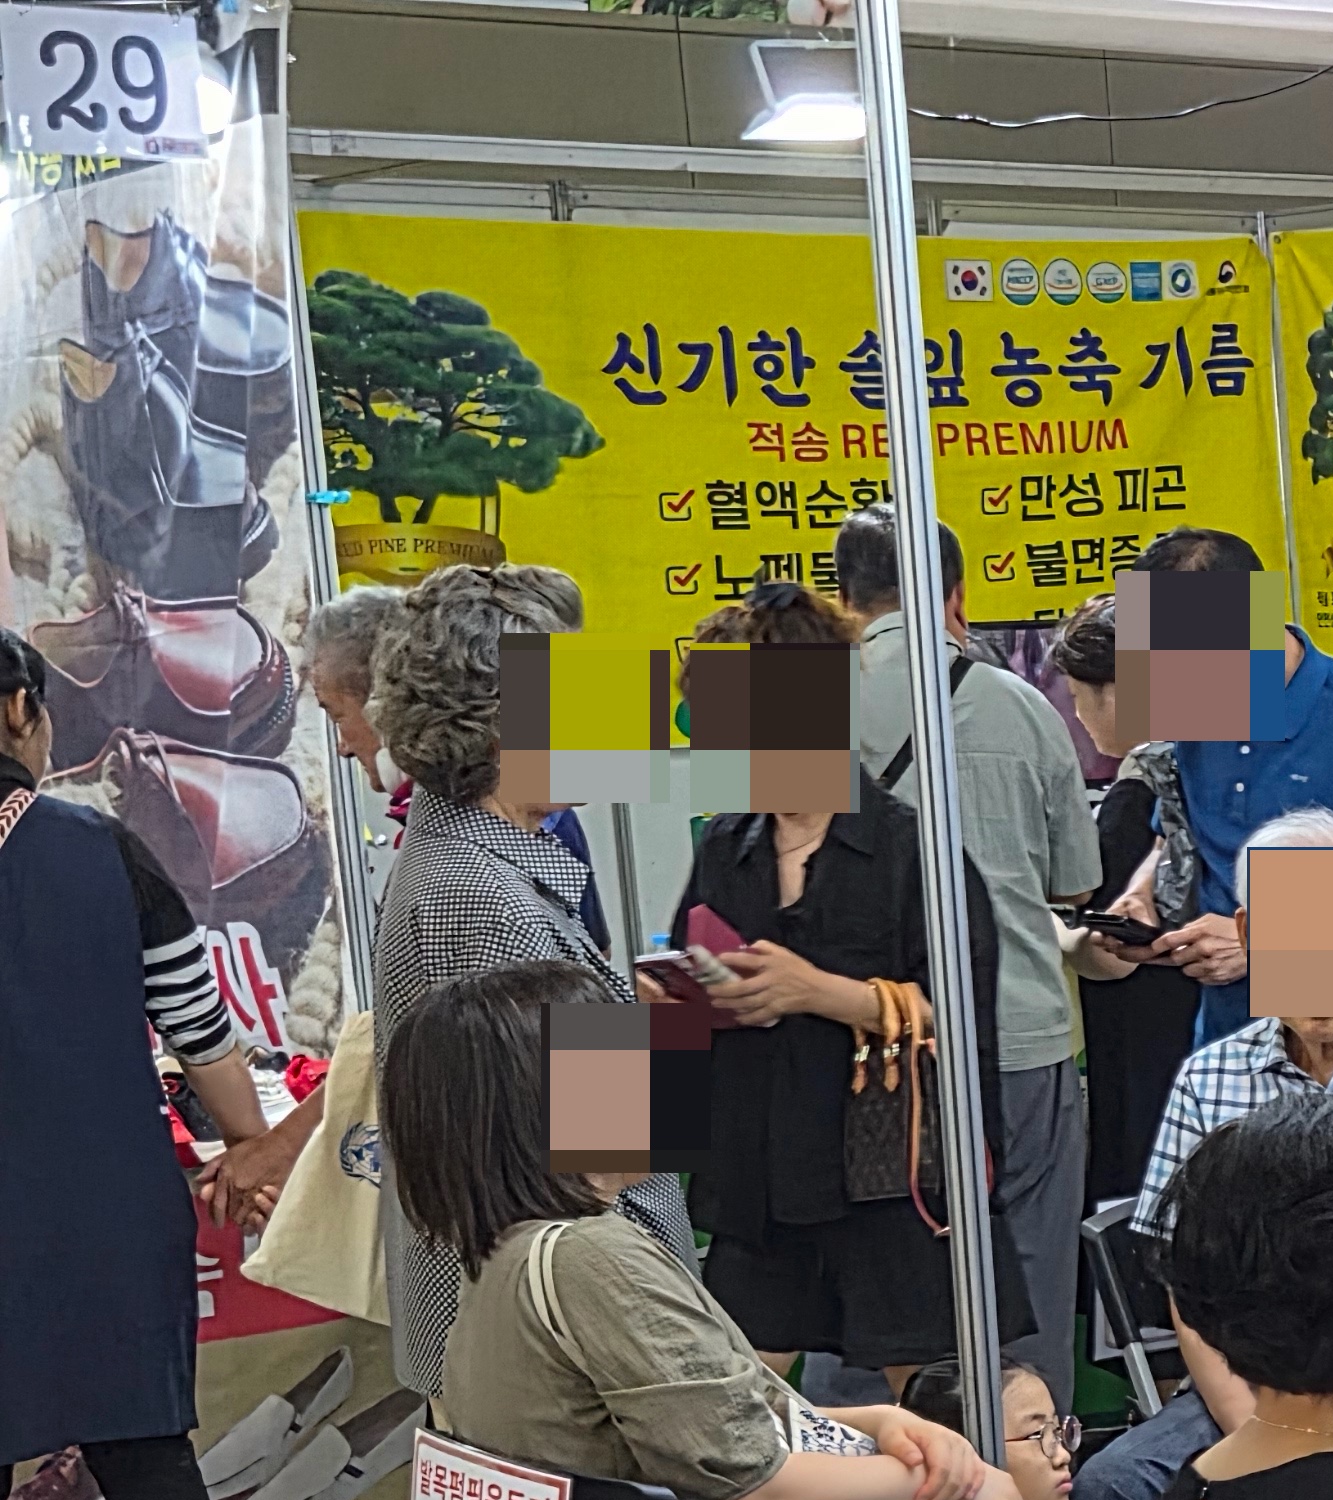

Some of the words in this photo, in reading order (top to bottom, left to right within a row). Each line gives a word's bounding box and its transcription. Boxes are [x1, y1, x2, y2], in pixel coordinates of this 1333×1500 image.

[38, 29, 171, 135] 29
[600, 322, 816, 407] 신기한
[990, 328, 1122, 407] 농축
[1138, 322, 1256, 398] 기름
[748, 421, 830, 462] 적송
[842, 423, 891, 459] RE
[939, 417, 1129, 458] PREMIUM
[1019, 473, 1106, 522] 만성
[1113, 464, 1187, 513] 피곤
[368, 538, 407, 555] PINE
